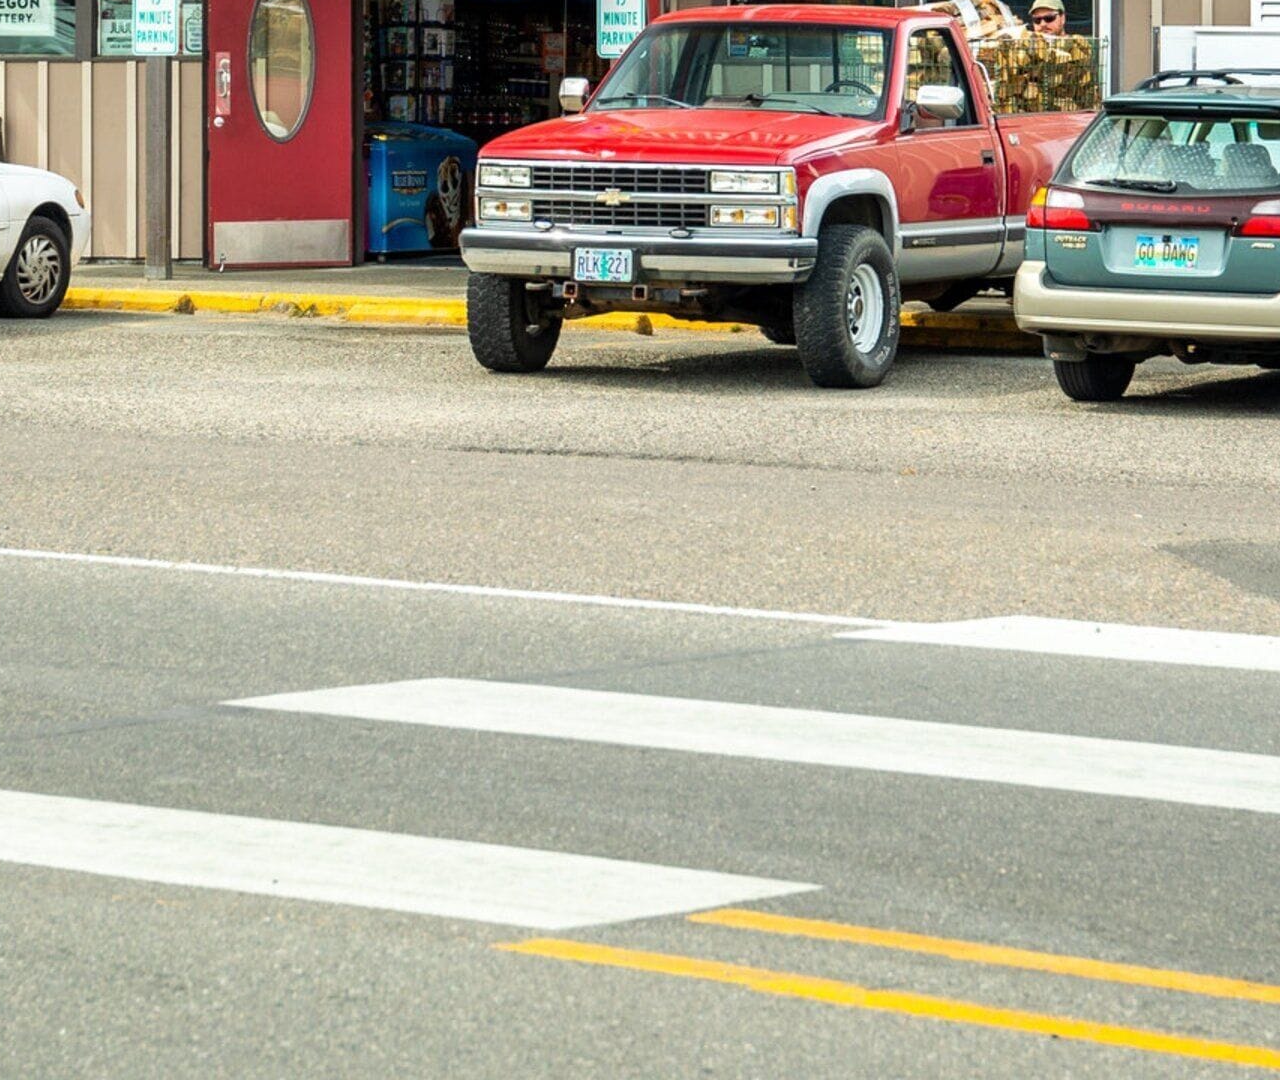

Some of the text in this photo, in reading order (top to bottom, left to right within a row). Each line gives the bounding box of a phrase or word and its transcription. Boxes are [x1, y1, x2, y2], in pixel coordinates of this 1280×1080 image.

[138, 11, 172, 25] MINUTE
[603, 11, 638, 25] MINUTE
[136, 30, 175, 44] PARKING
[601, 30, 639, 45] PARKIN
[1138, 243, 1195, 262] GO DAWG
[578, 256, 628, 275] RLK 221
